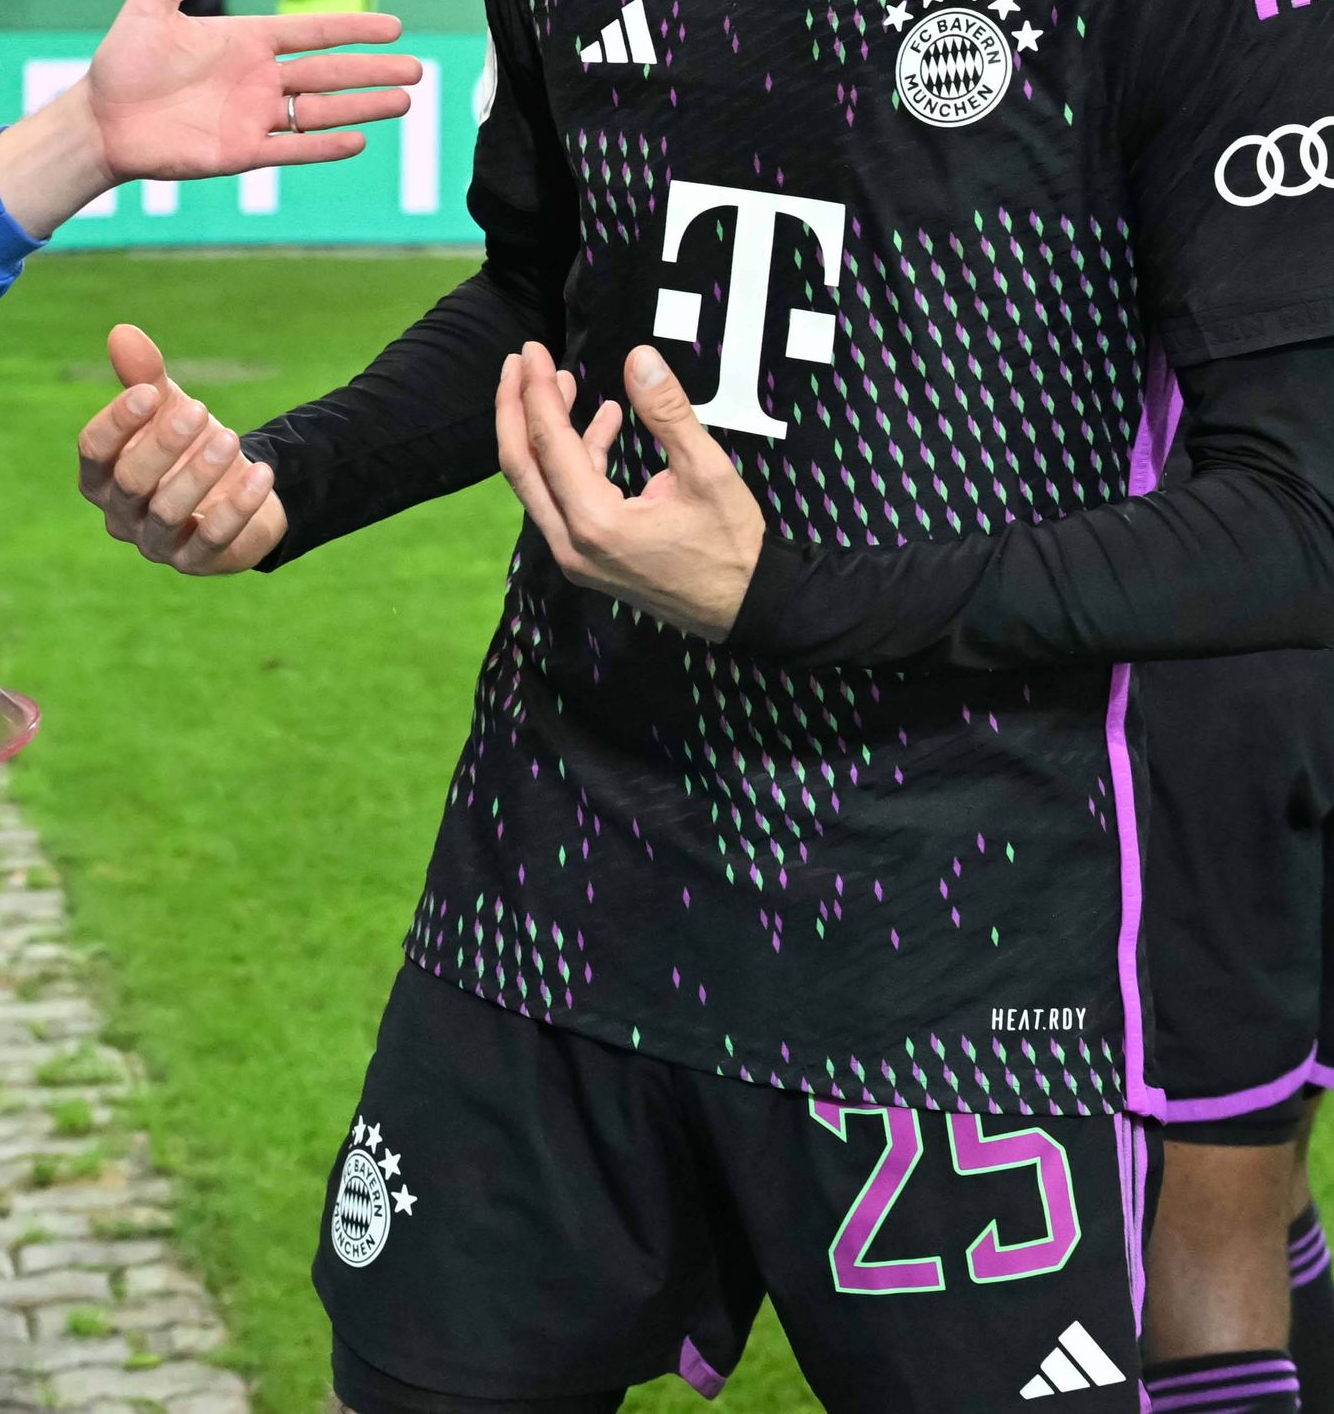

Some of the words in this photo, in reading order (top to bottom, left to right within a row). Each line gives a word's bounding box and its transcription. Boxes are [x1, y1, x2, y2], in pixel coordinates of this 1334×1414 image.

[910, 28, 933, 54] FC
[936, 17, 1002, 65] BAYERN
[904, 73, 995, 118] MÜNCHEN
[653, 179, 846, 441] T
[991, 1007, 1087, 1031] HEAT.RDY
[353, 1158, 384, 1218] BAYERN
[808, 1095, 1082, 1295] 25
